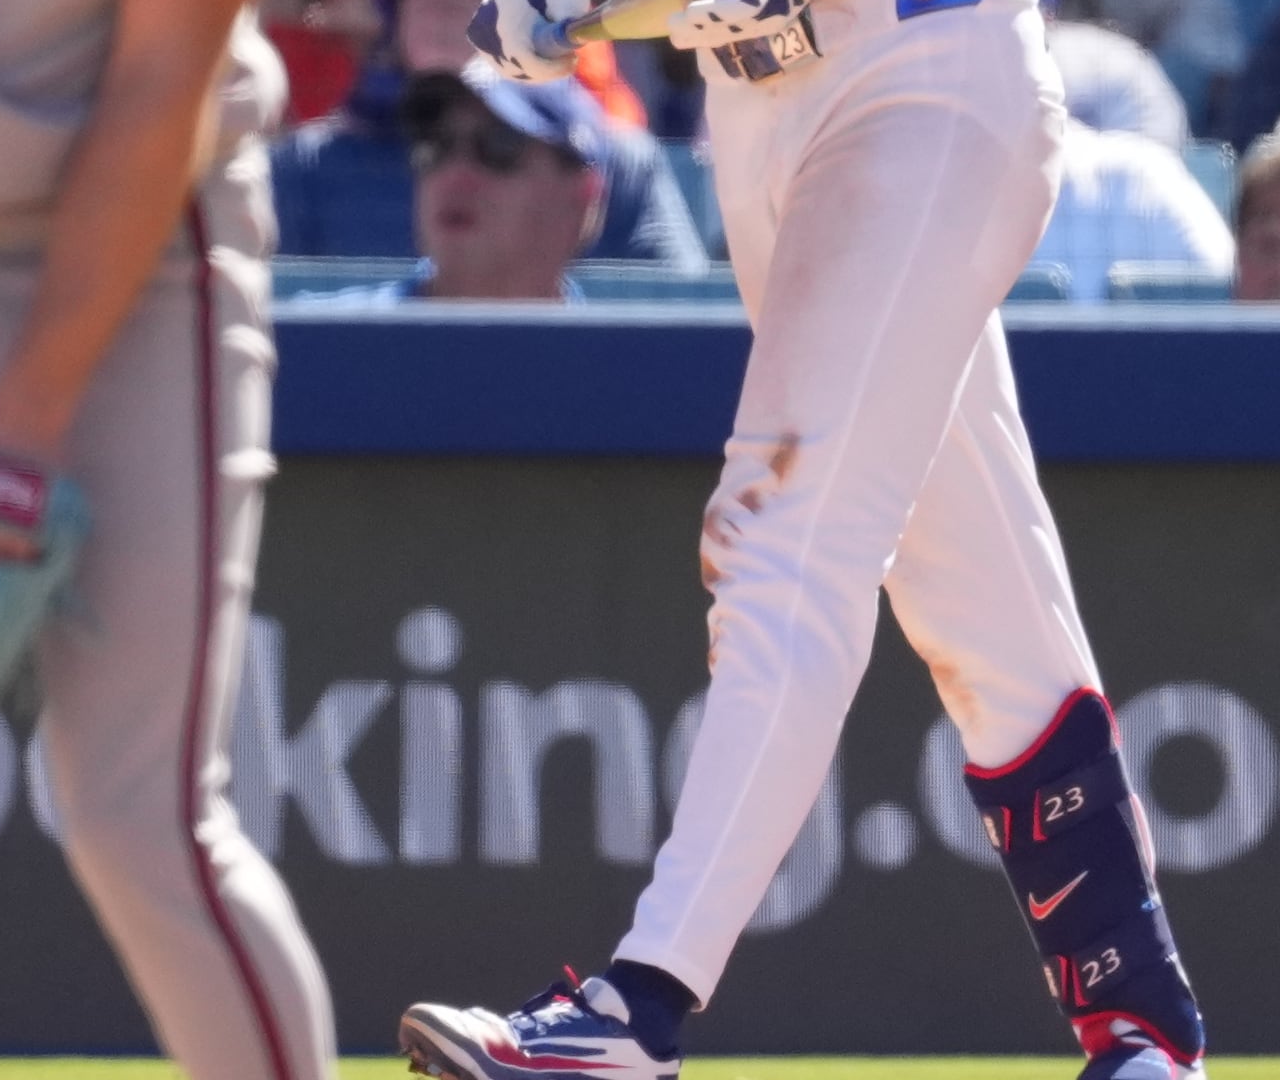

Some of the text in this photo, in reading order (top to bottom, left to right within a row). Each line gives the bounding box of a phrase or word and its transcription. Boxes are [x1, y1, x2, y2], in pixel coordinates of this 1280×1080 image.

[773, 27, 805, 61] 23
[1044, 786, 1084, 822] 23
[1082, 947, 1121, 988] 23
